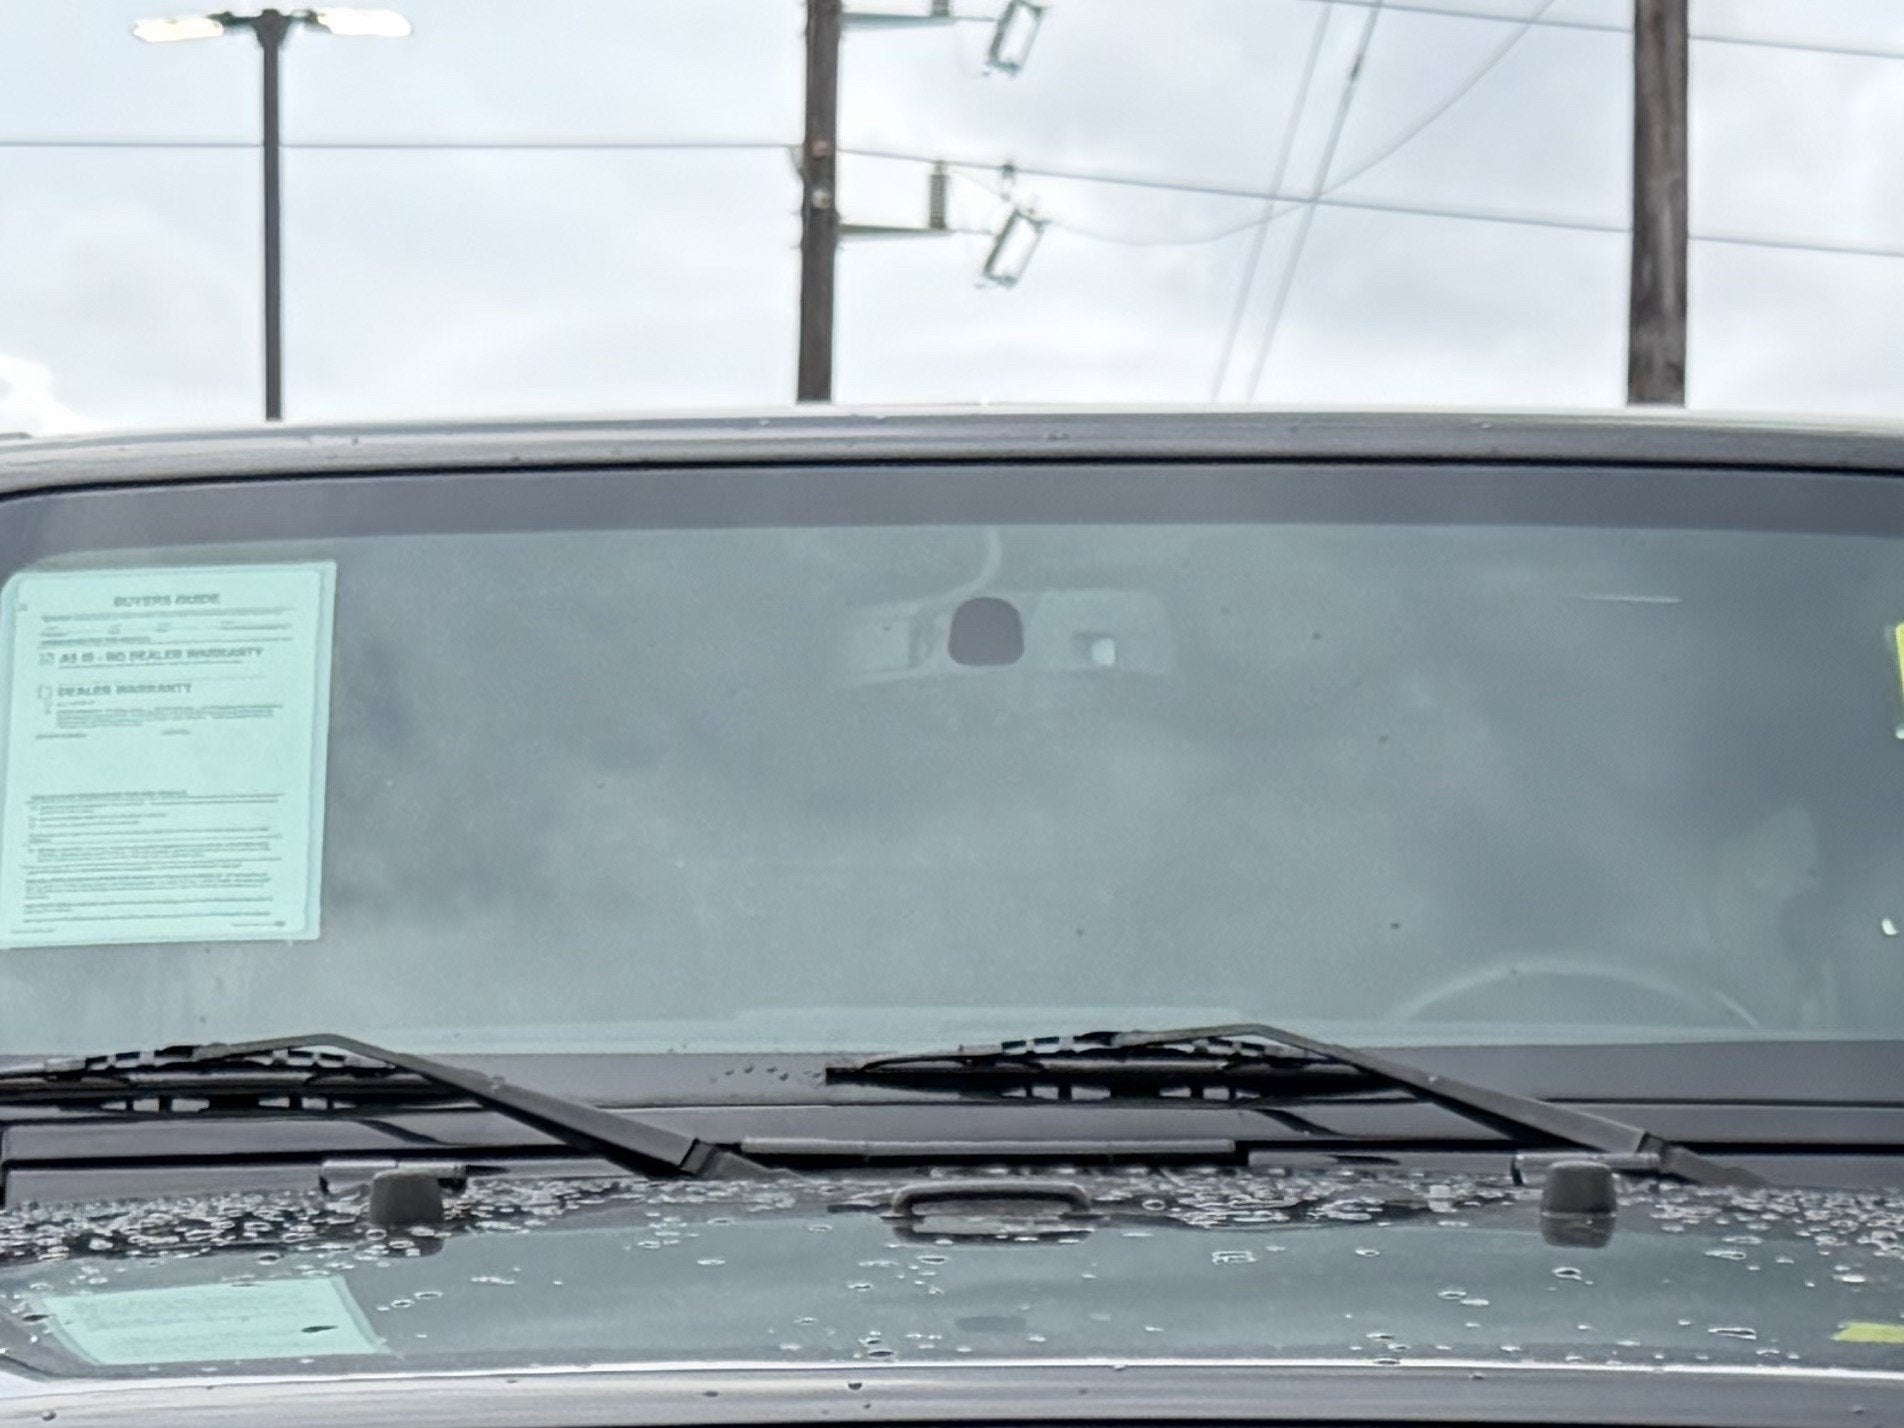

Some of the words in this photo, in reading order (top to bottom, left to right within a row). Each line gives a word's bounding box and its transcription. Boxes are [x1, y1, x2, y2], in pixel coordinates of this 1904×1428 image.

[113, 595, 172, 608] BUYERS
[175, 593, 220, 605] GUIDE
[129, 650, 182, 661] DEALER
[187, 647, 264, 658] WARRANTY
[57, 685, 112, 697] DEALER
[116, 683, 192, 695] WARRANTY
